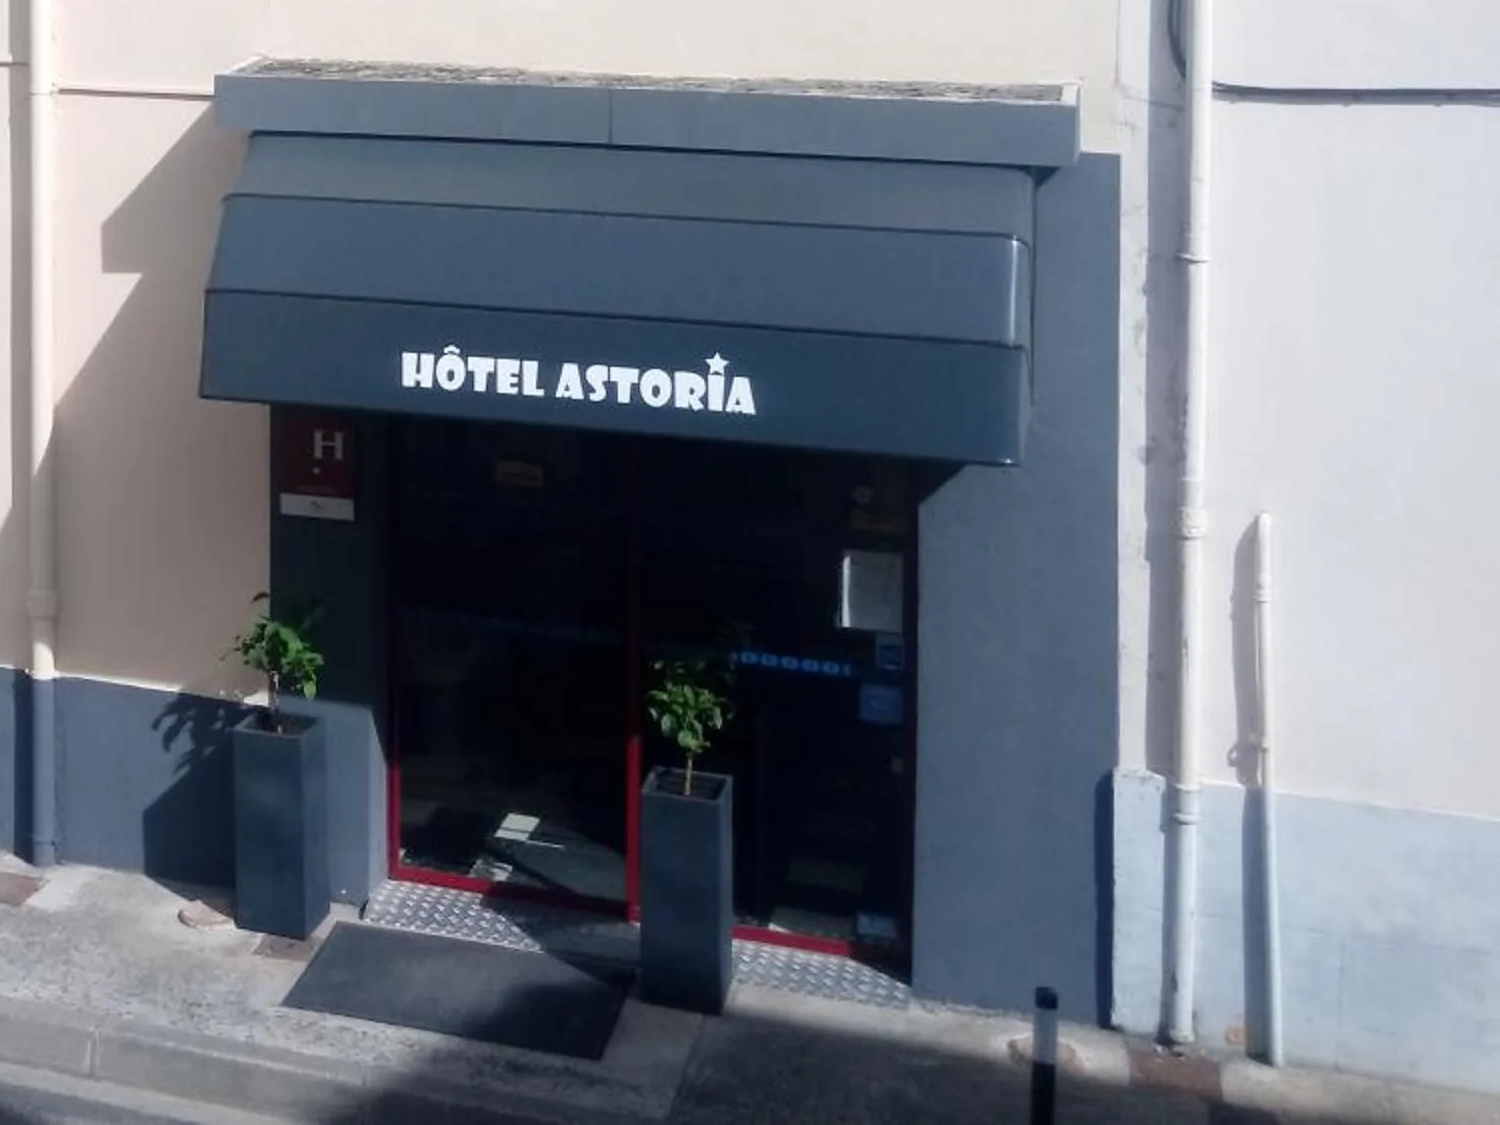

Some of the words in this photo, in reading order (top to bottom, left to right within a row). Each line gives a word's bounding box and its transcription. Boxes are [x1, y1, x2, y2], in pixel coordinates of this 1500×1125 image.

[401, 345, 545, 396] HÔTEL
[555, 353, 756, 415] ASTORIA
[313, 429, 344, 460] H
